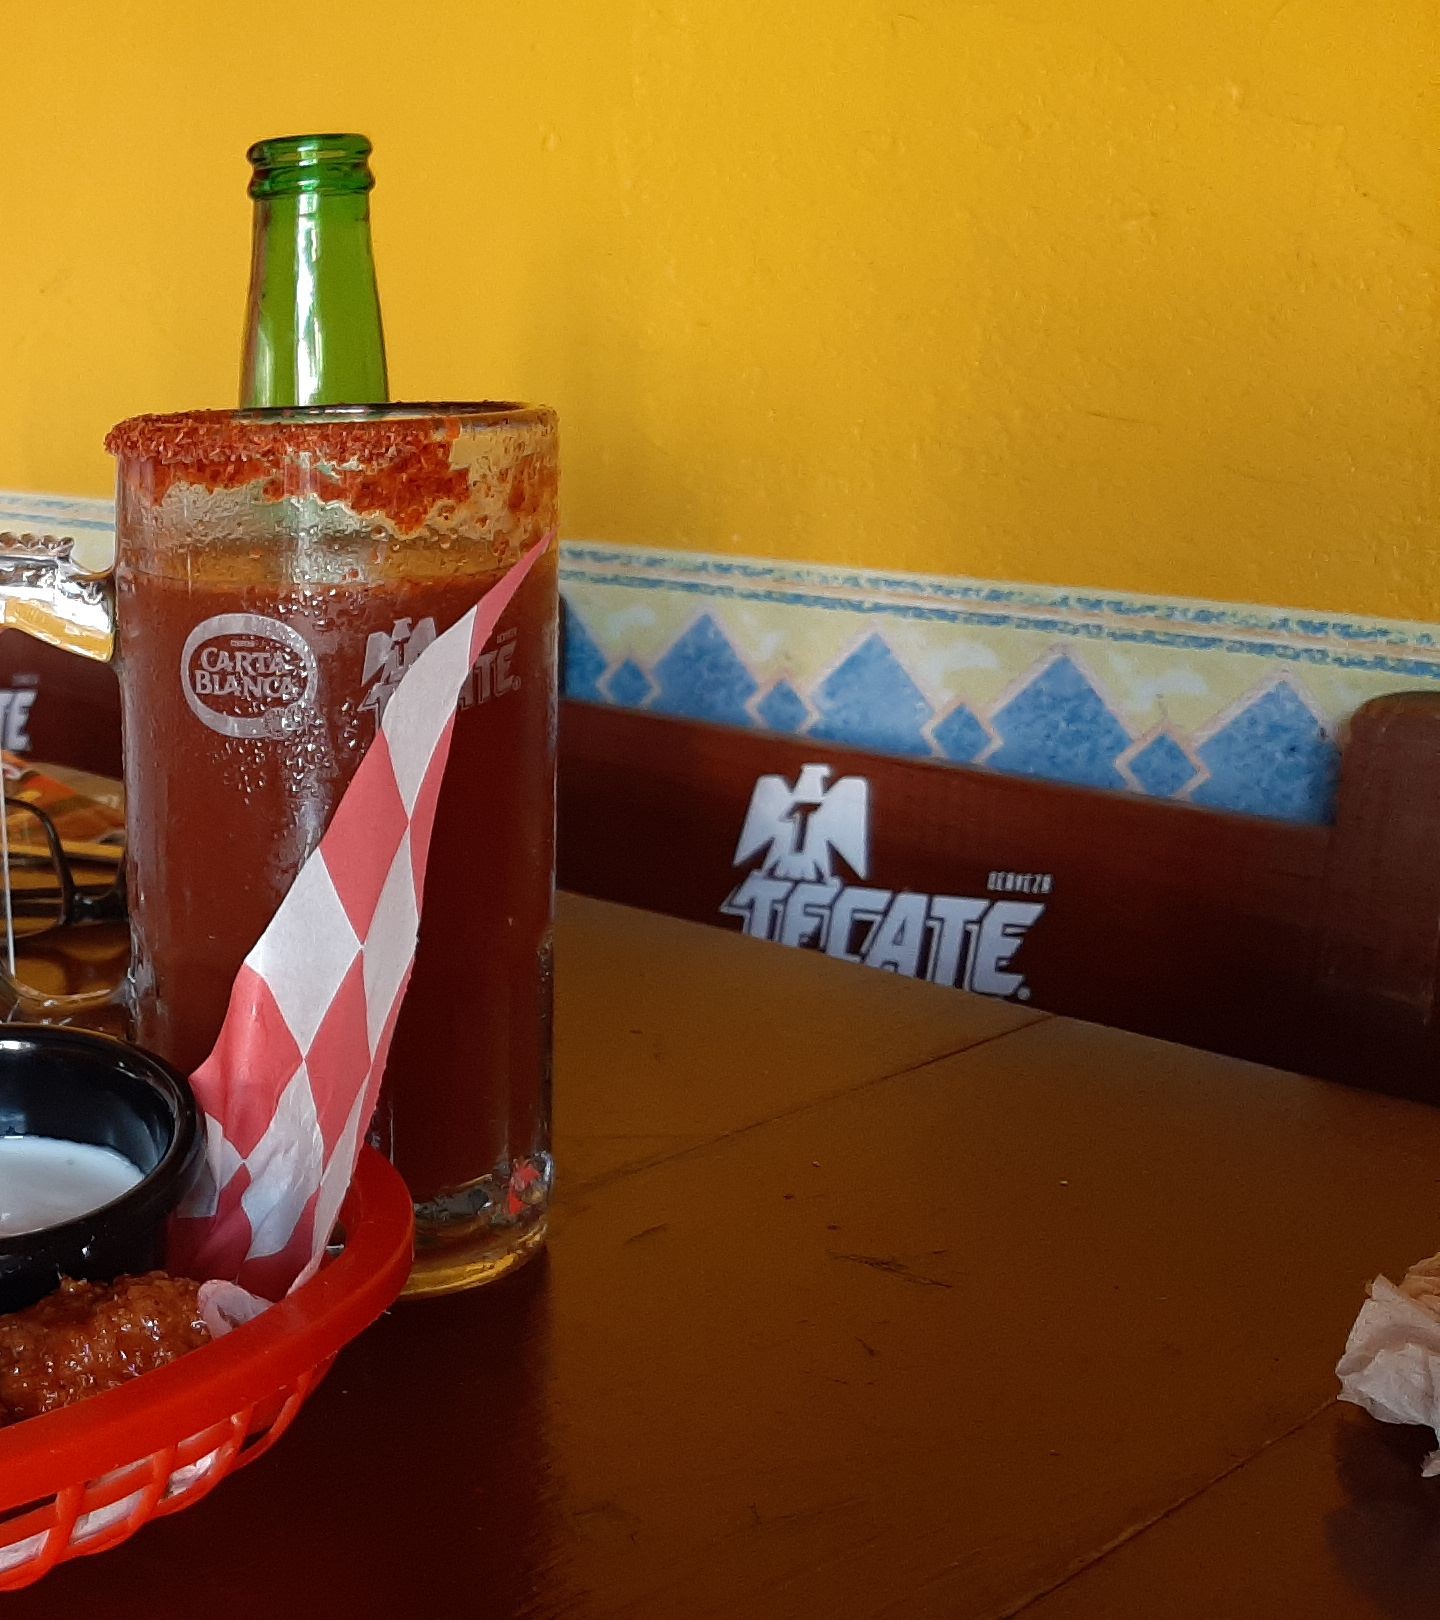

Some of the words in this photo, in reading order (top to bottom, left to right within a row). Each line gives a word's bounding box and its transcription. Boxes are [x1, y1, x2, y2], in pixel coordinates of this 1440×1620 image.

[200, 647, 291, 677] CARTA
[194, 669, 298, 699] BLANCA
[720, 870, 1047, 998] TECATE
